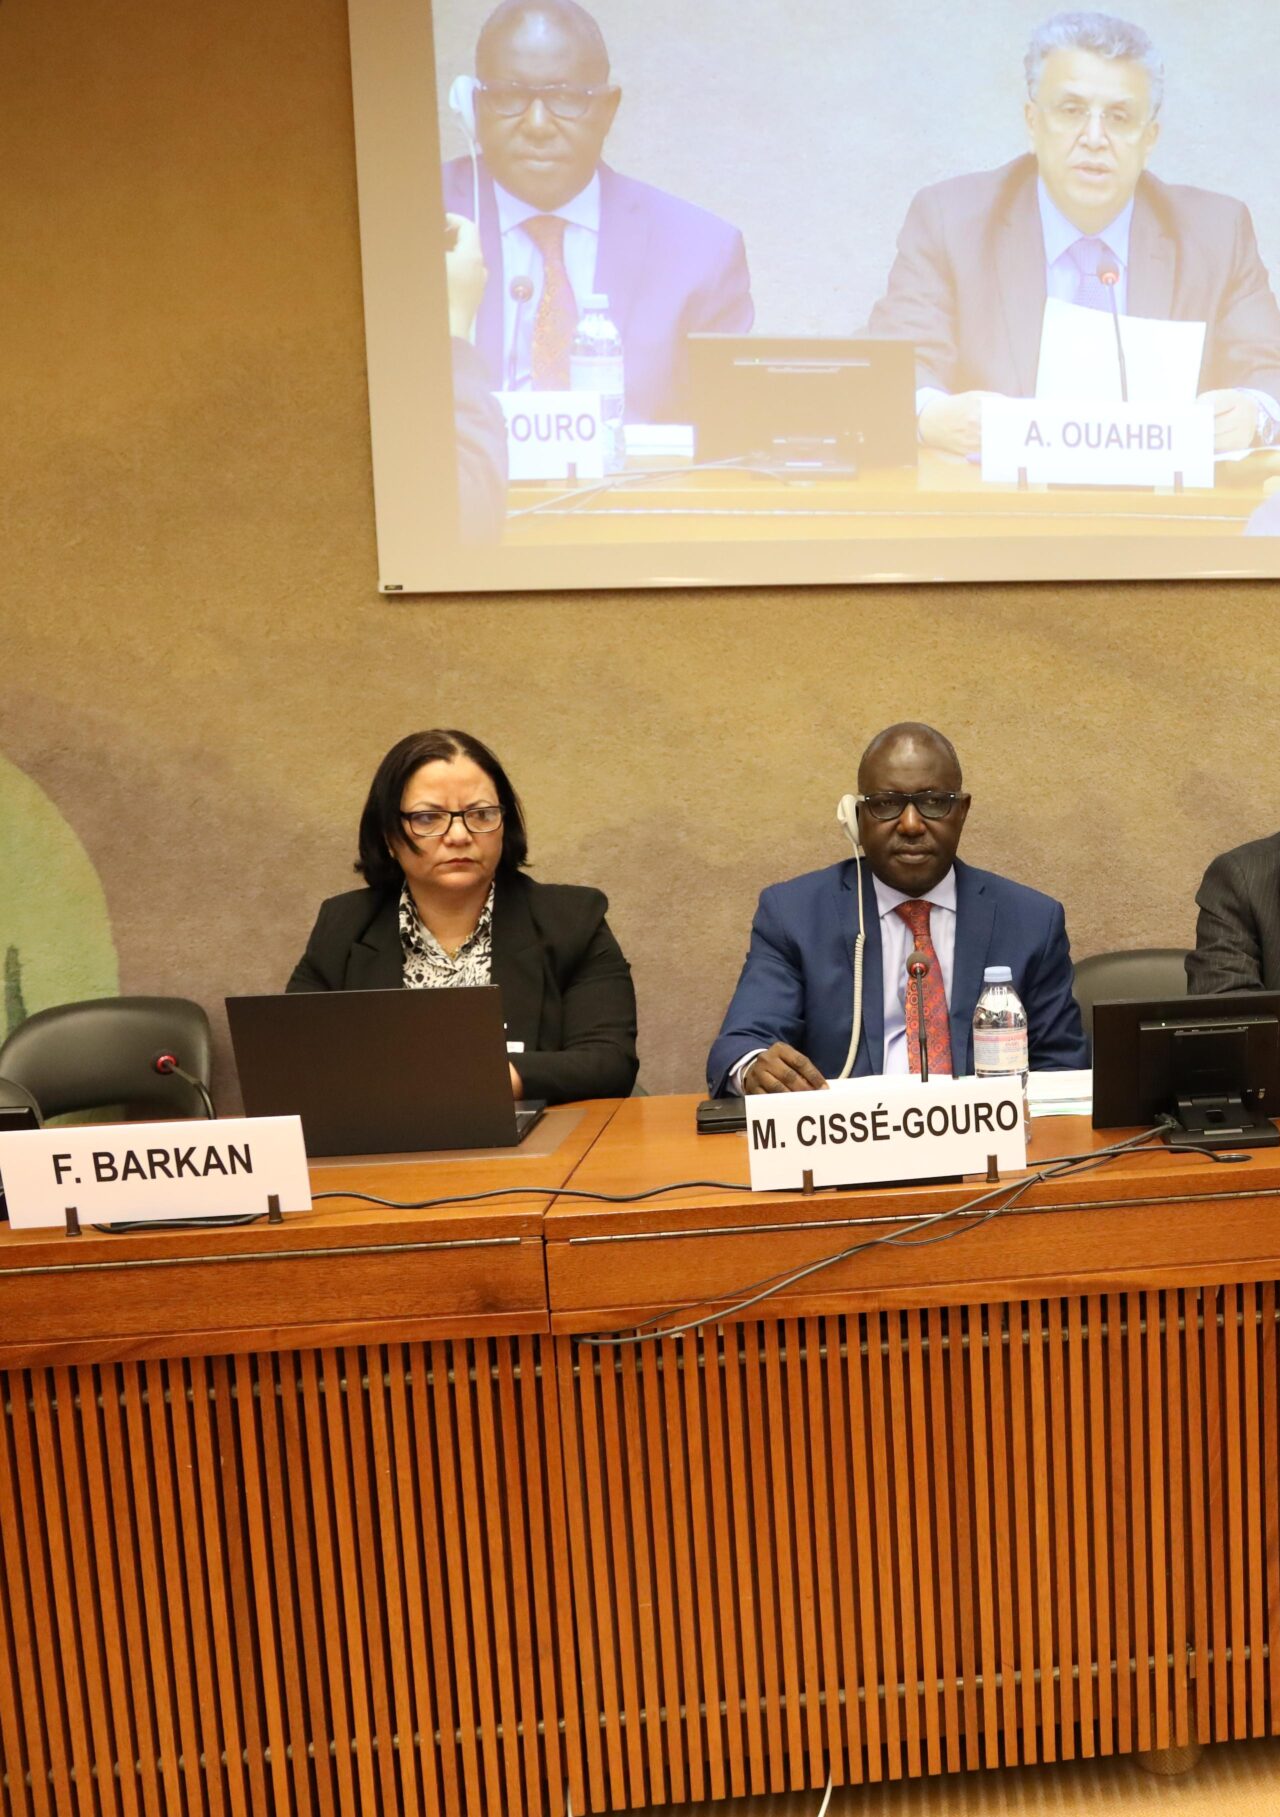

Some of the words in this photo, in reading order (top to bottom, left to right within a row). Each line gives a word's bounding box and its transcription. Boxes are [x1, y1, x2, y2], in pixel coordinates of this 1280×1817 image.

[505, 413, 596, 443] OURO
[1024, 420, 1052, 447] A.
[1061, 421, 1173, 451] OUAHBI
[752, 1118, 787, 1150] M.
[796, 1100, 1018, 1147] CISSÉ-GOURO
[52, 1153, 82, 1185] F.
[92, 1143, 253, 1183] BARKAN
